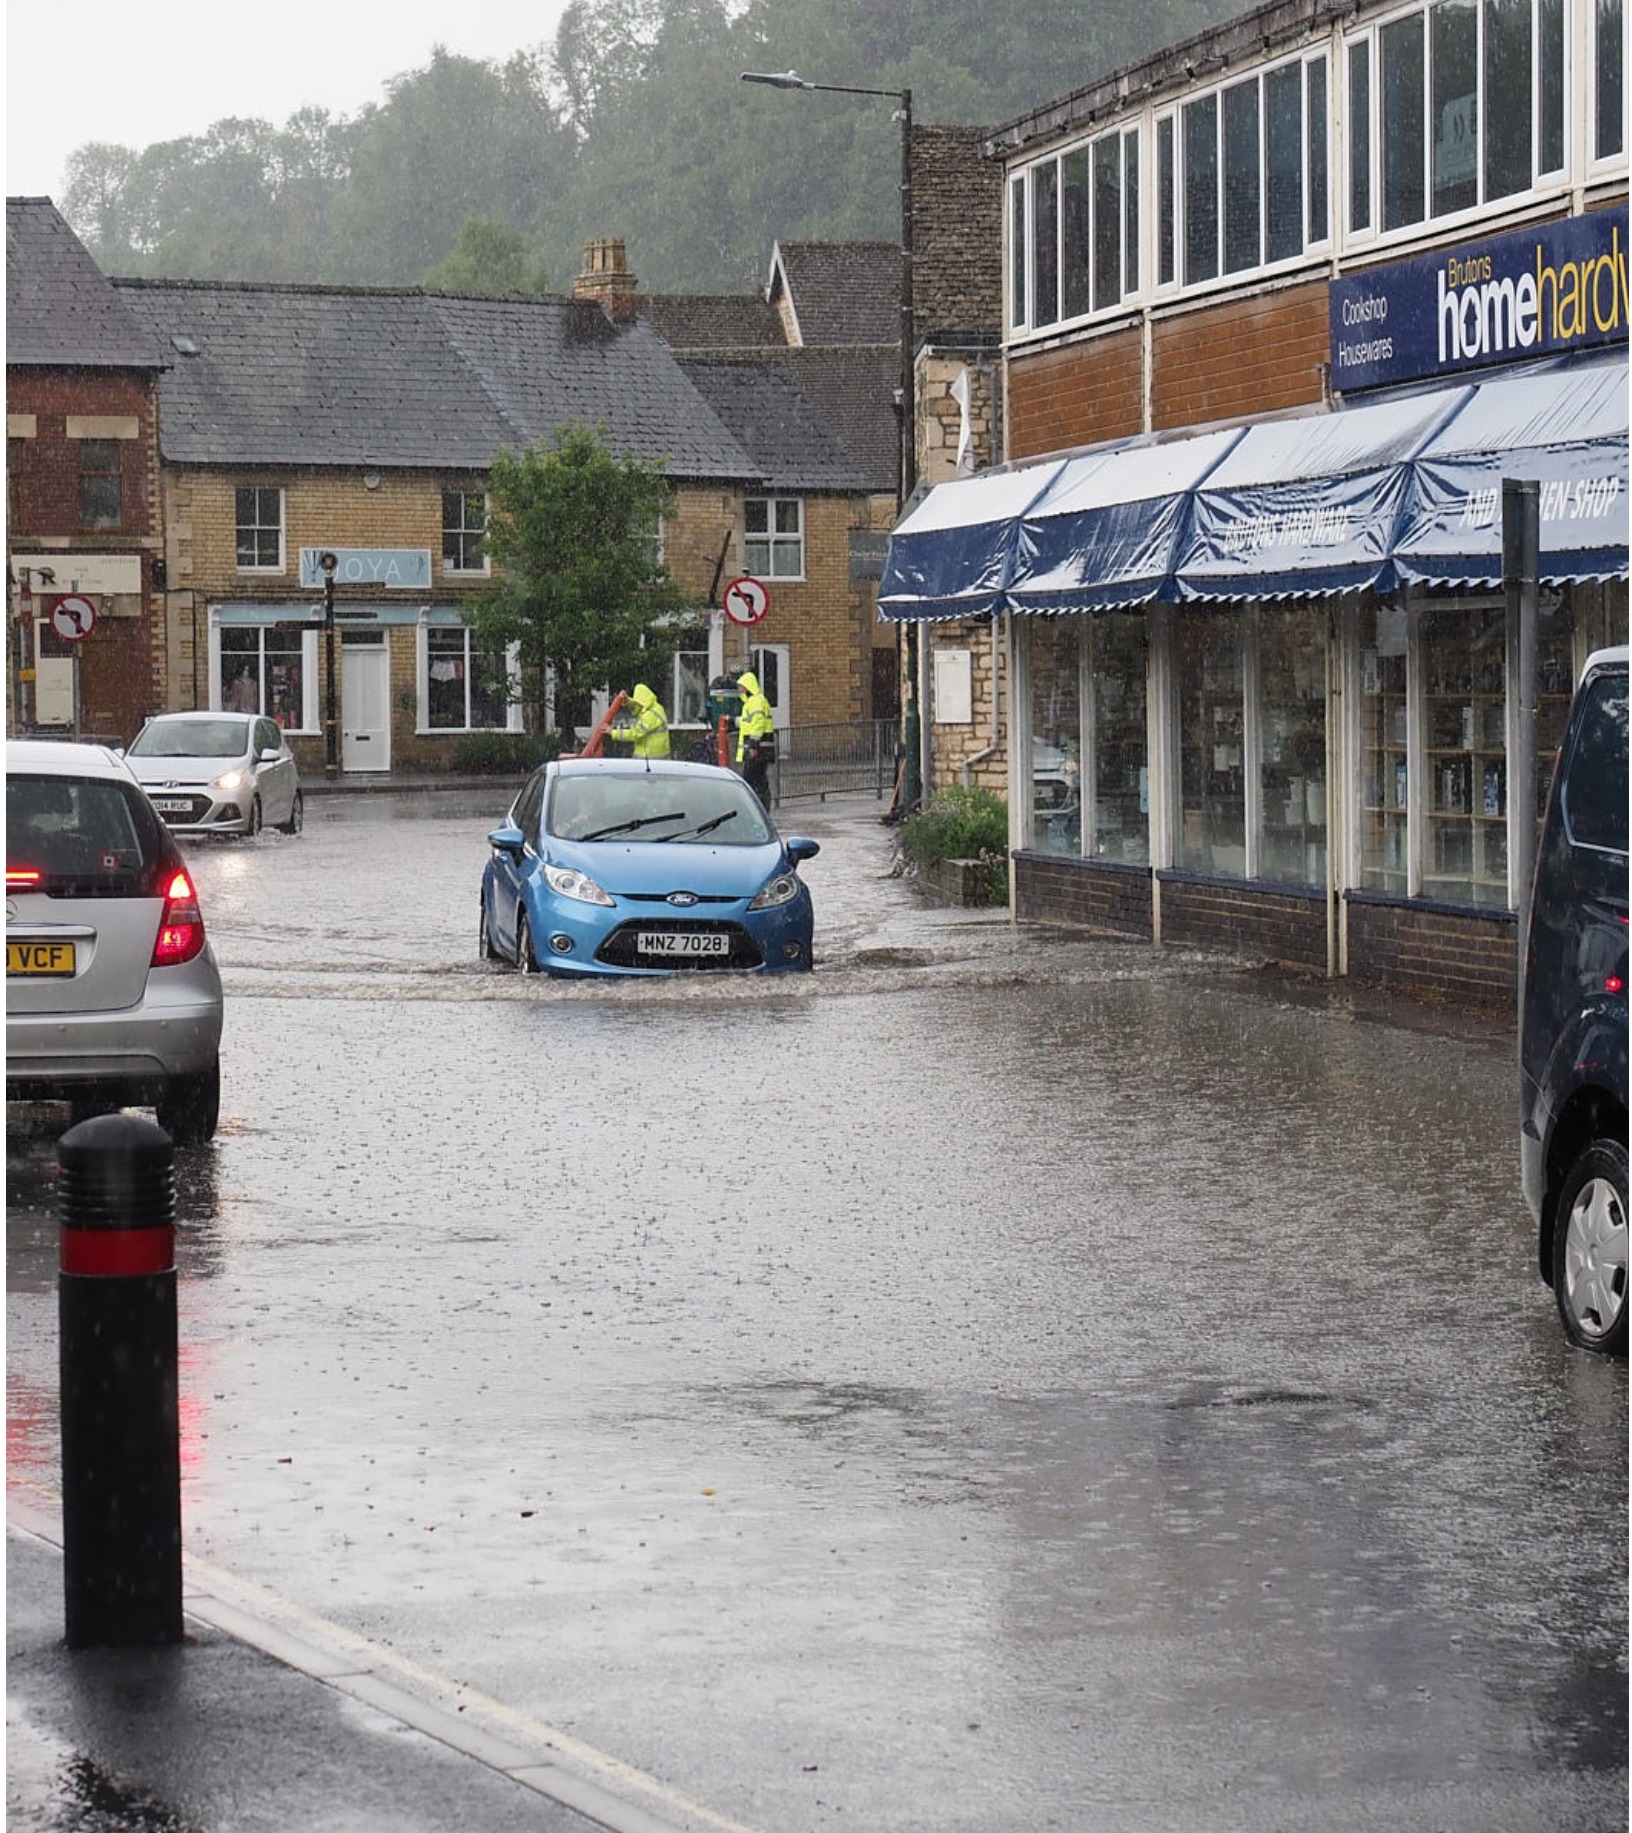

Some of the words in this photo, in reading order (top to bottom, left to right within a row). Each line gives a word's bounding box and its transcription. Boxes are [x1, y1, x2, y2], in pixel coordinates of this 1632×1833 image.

[1448, 254, 1492, 288] Brutons
[1342, 295, 1388, 327] Cookshop
[1338, 336, 1393, 368] Housewares
[1570, 476, 1620, 520] SHOP
[18, 946, 64, 968] VCF
[644, 935, 676, 951] MNZ
[681, 936, 722, 951] 7028
